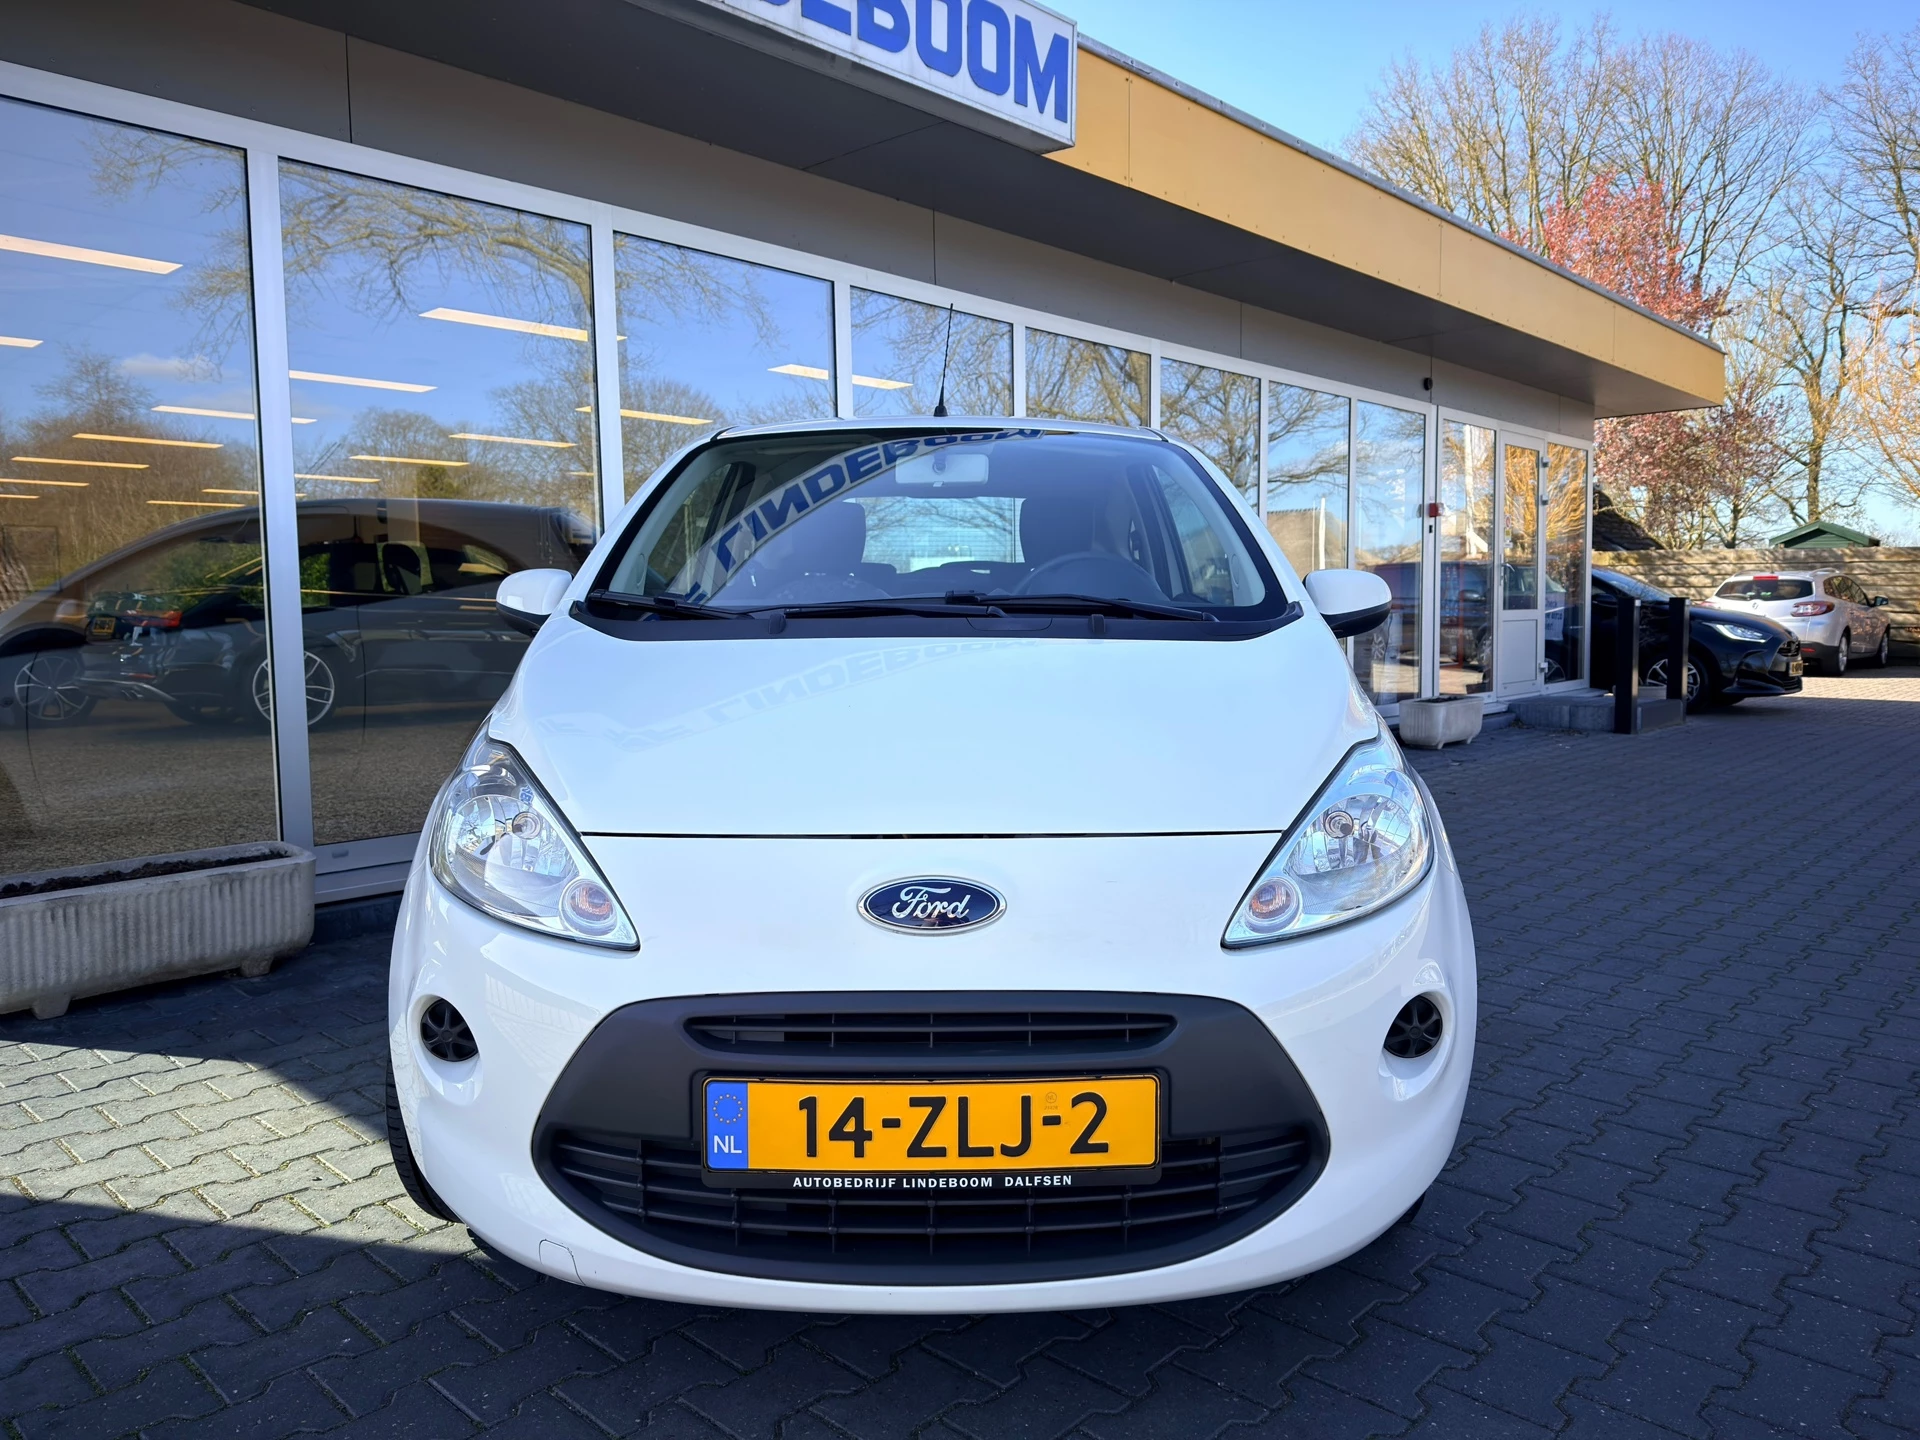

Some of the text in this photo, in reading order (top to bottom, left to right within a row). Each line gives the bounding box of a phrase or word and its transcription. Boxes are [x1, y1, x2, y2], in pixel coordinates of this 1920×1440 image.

[759, 0, 1069, 123] BOOM
[891, 886, 971, 918] Ford
[713, 1092, 1109, 1157] NL 14-ZLJ-2
[793, 1175, 1072, 1188] AUTOBEDRIJF LINDEBOOM DALFSEN
